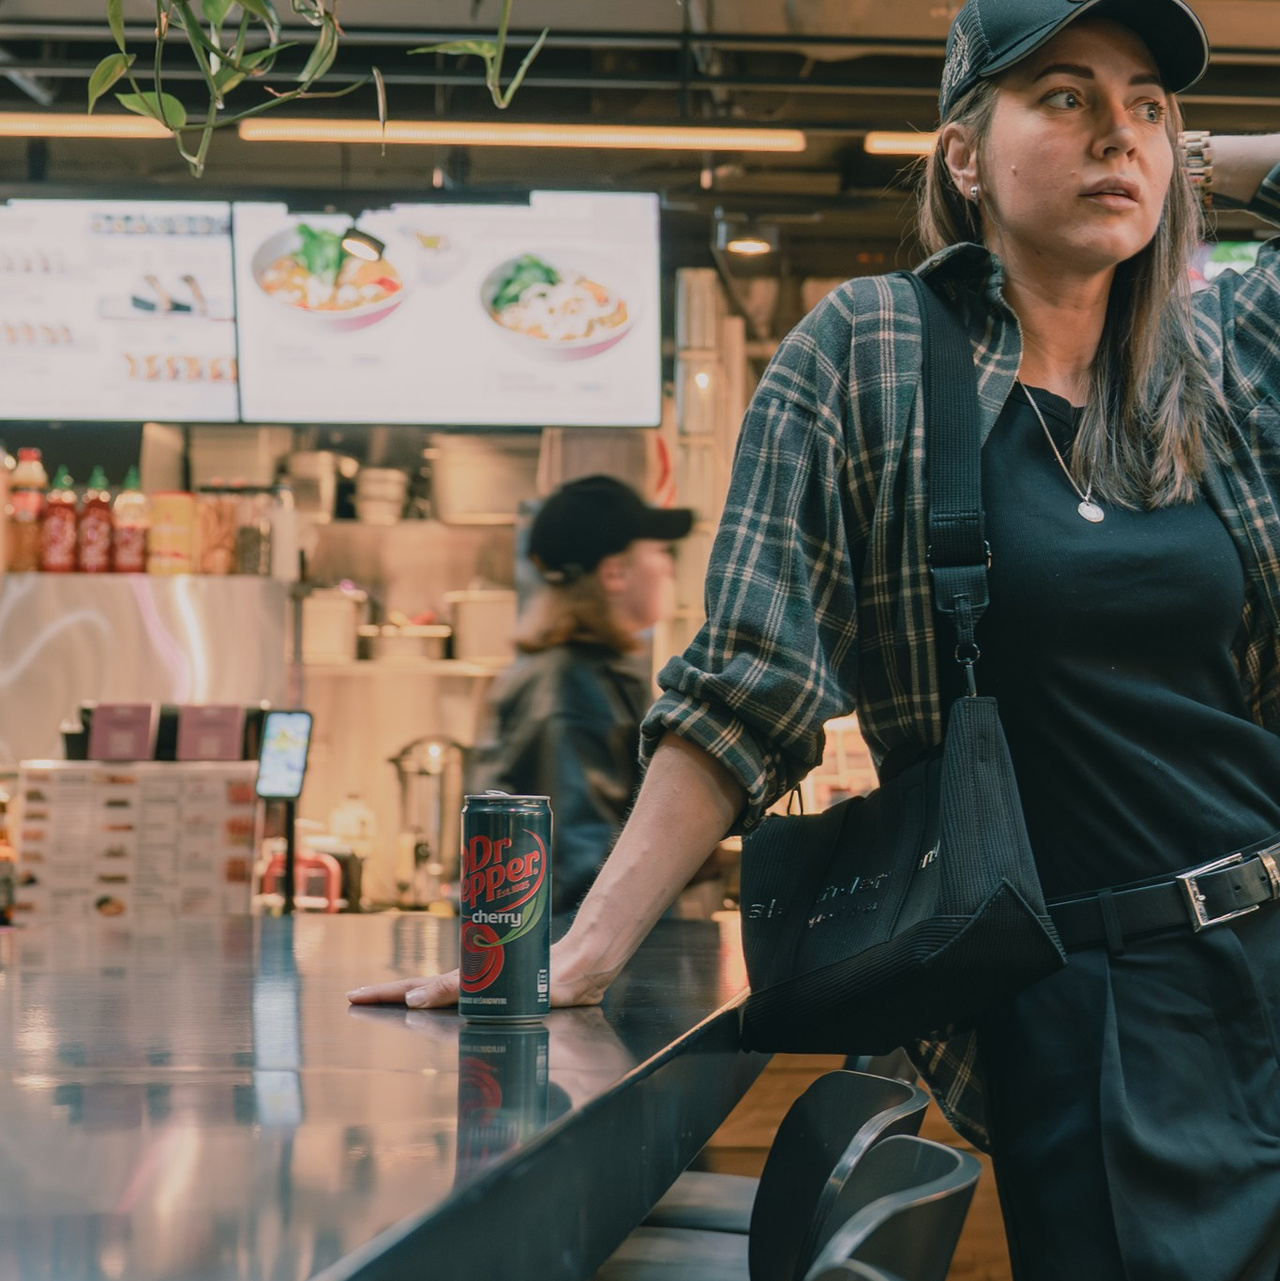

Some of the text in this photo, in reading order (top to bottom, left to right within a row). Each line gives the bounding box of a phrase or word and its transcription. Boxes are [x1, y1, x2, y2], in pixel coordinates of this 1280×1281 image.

[469, 835, 512, 875] Dr
[461, 850, 540, 909] epper
[472, 910, 521, 927] cherry
